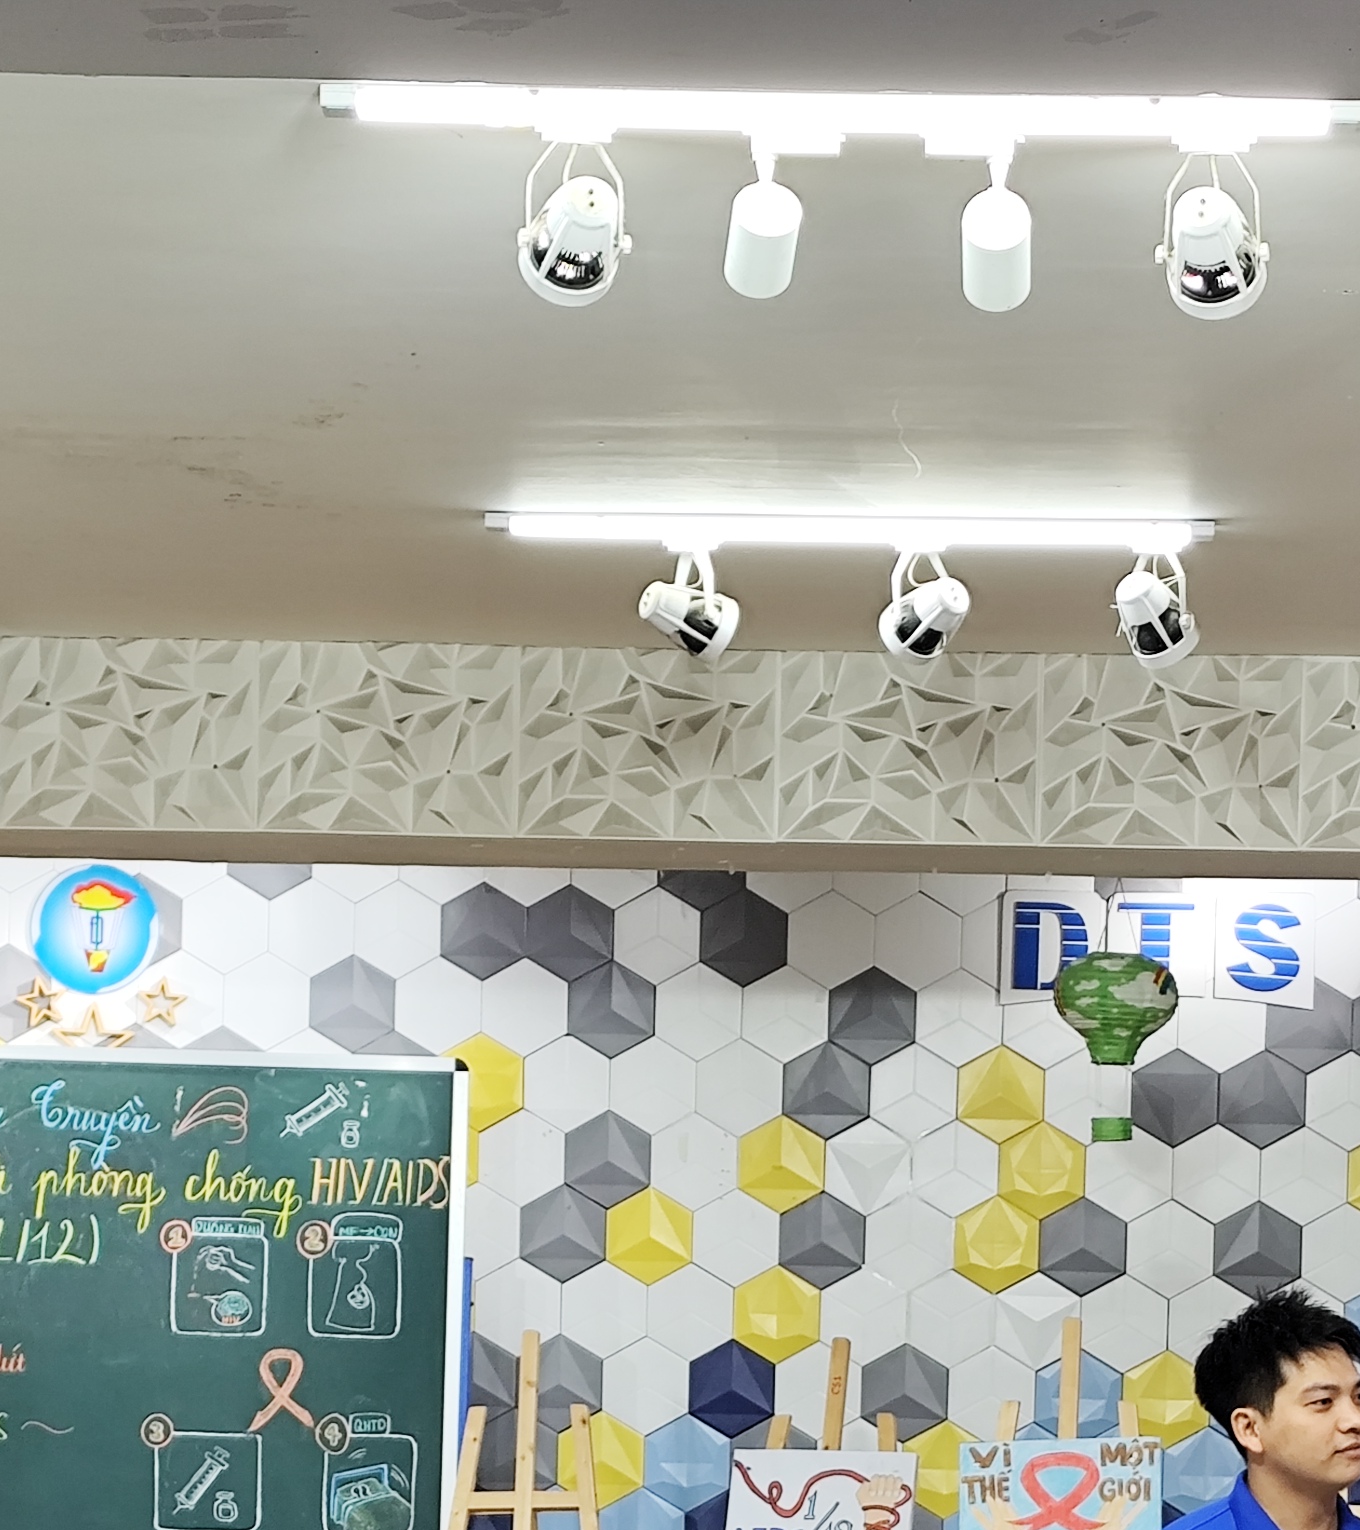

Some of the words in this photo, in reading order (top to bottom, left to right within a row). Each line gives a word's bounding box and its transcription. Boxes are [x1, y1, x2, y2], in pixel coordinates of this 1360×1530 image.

[185, 1148, 303, 1238] chống
[307, 1155, 451, 1210] HIV/AIDS
[969, 1442, 1012, 1469] VÌ
[1099, 1439, 1161, 1470] MỘT
[961, 1468, 1013, 1504] THẾ
[1098, 1470, 1152, 1503] GIỚI
